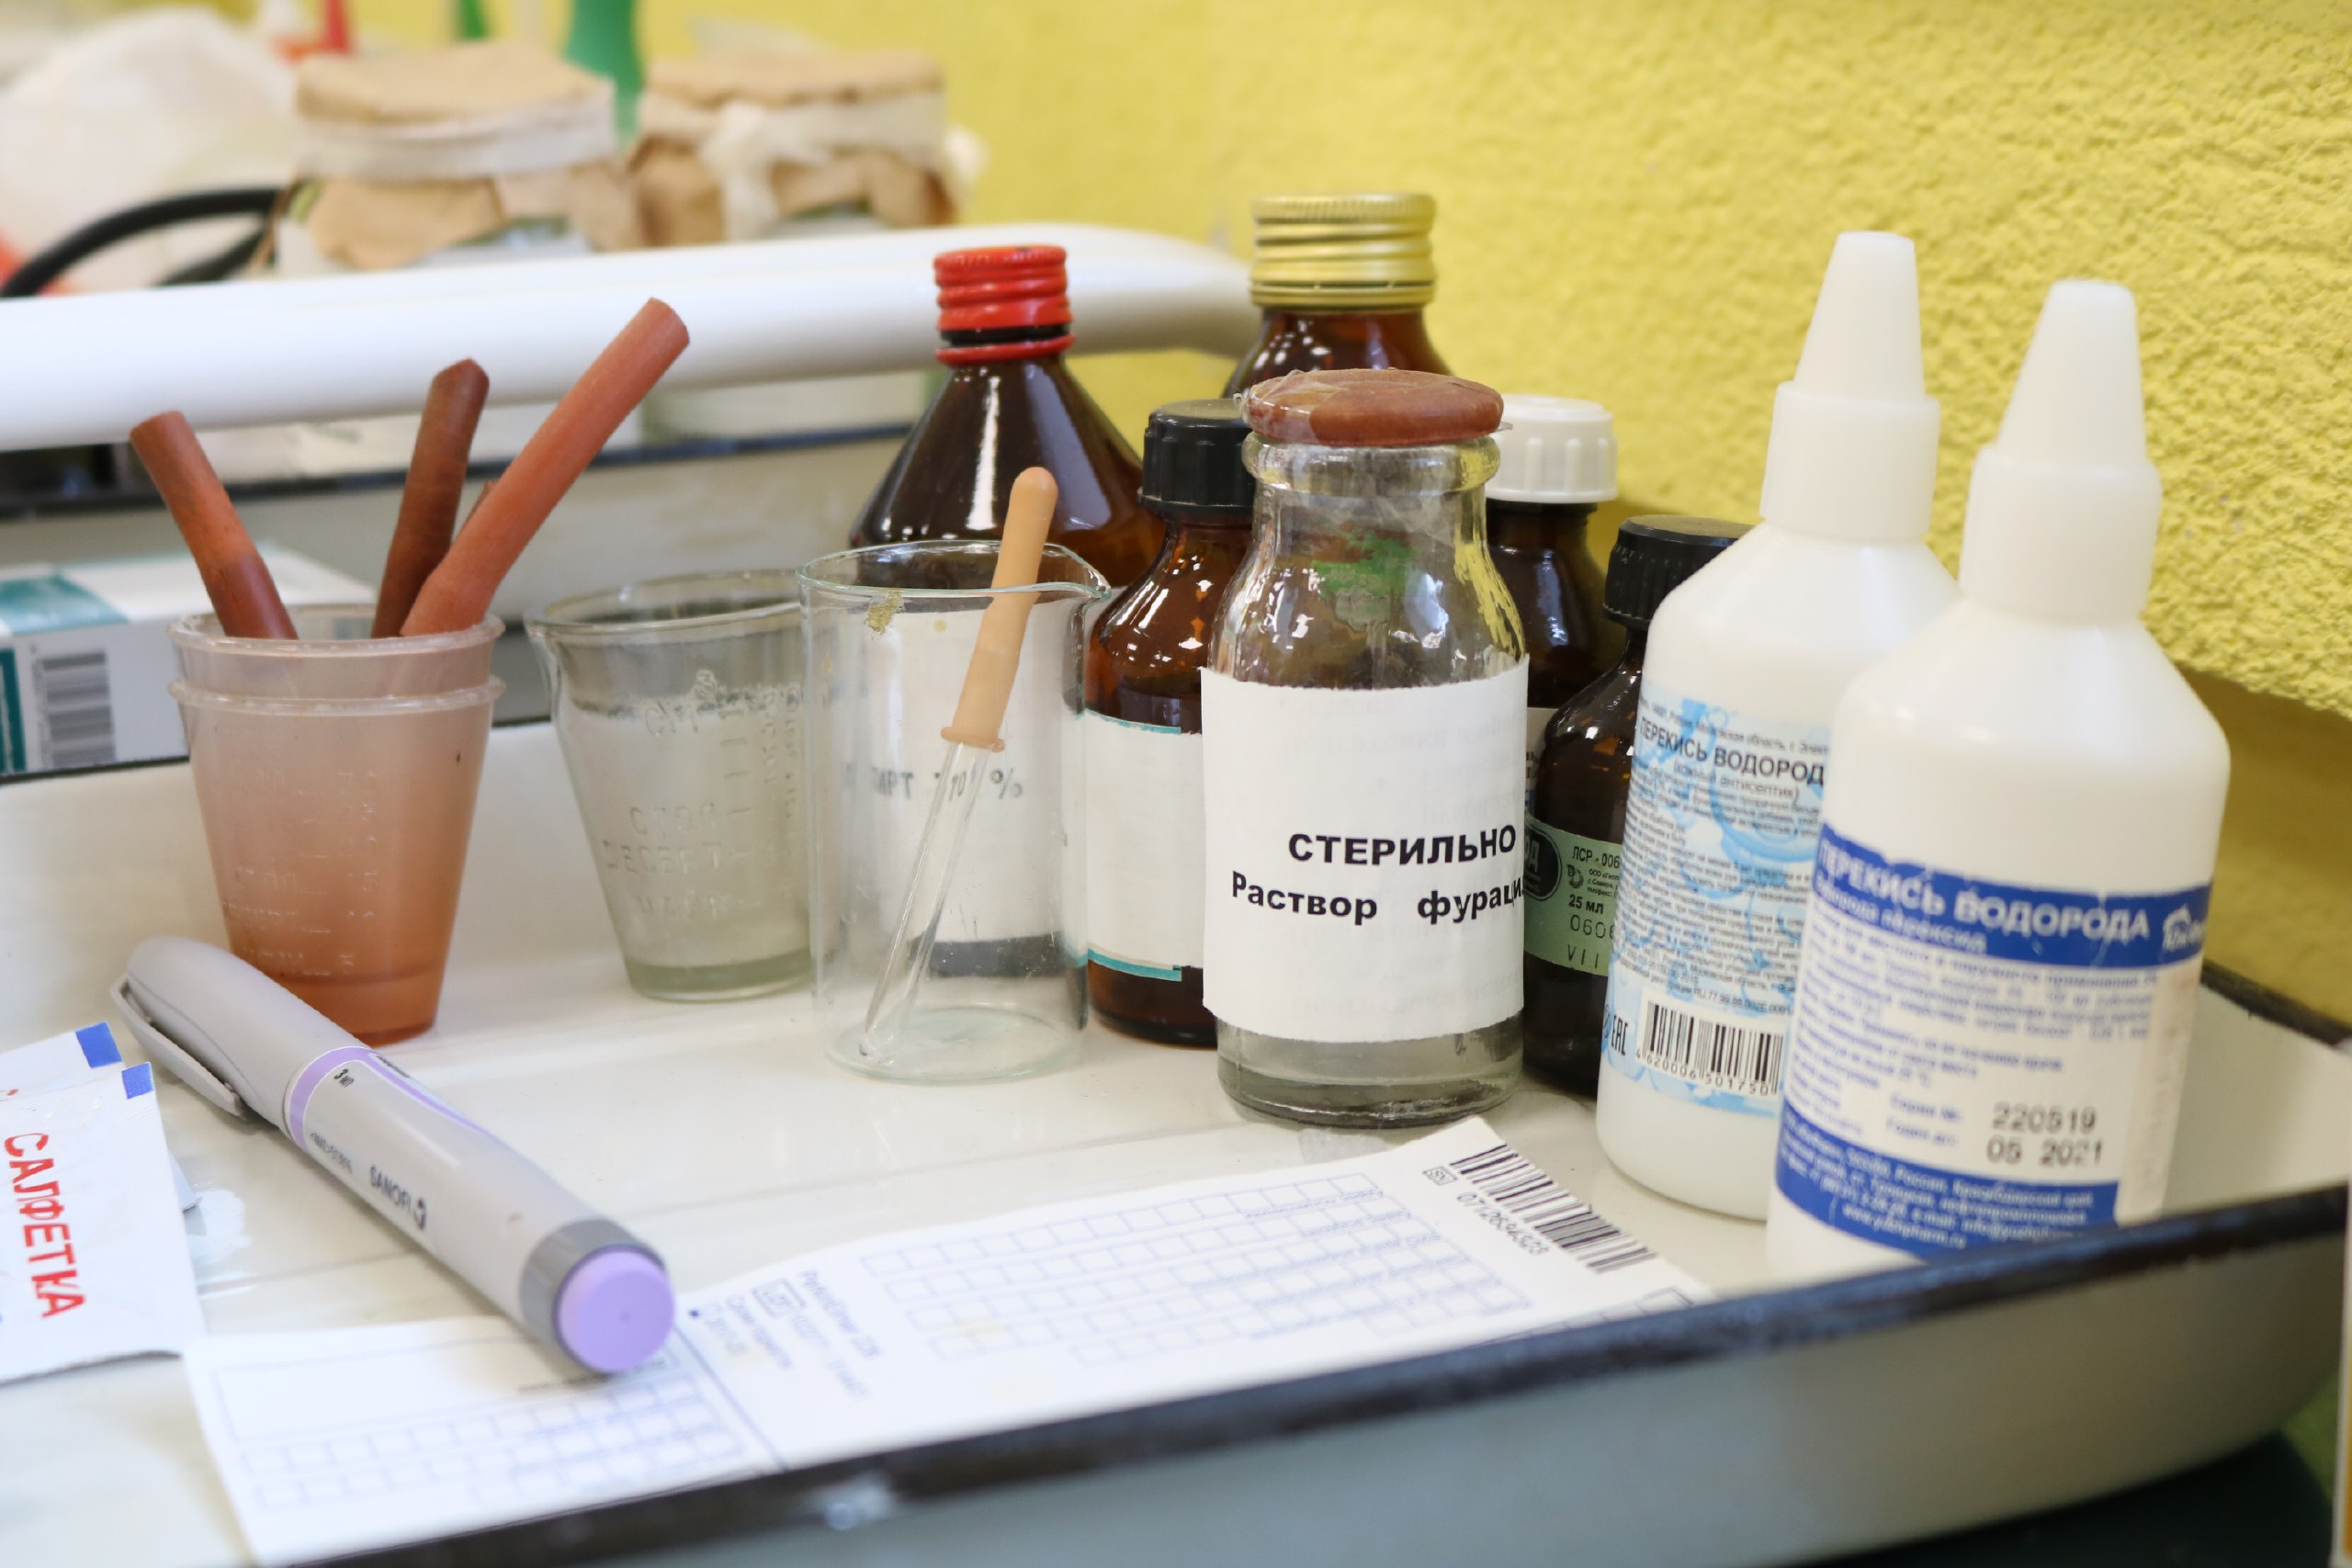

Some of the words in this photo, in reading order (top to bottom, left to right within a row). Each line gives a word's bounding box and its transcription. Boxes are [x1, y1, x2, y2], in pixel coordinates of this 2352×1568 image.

[1641, 716, 1708, 761] ПЕРЕКИСЬ
[1714, 747, 1825, 786] ВОДОРОД
[1289, 825, 1516, 865] СТЕРИЛЬНО
[1572, 845, 1593, 863] ЛСР
[1232, 871, 1377, 925] Раствор
[1417, 877, 1524, 925] фураци
[1568, 894, 1583, 909] 25
[1586, 900, 1604, 915] мл
[1820, 838, 1947, 917] ПЕРЕКИСЬ
[1953, 885, 2150, 947] ВОДОРОДА
[1646, 1055, 1697, 1080] 620006
[1704, 1073, 1770, 1097] 501750
[2038, 1137, 2103, 1168] 2021
[369, 1163, 413, 1213] SANOFI
[4, 1132, 86, 1318] САЛФЕТКА
